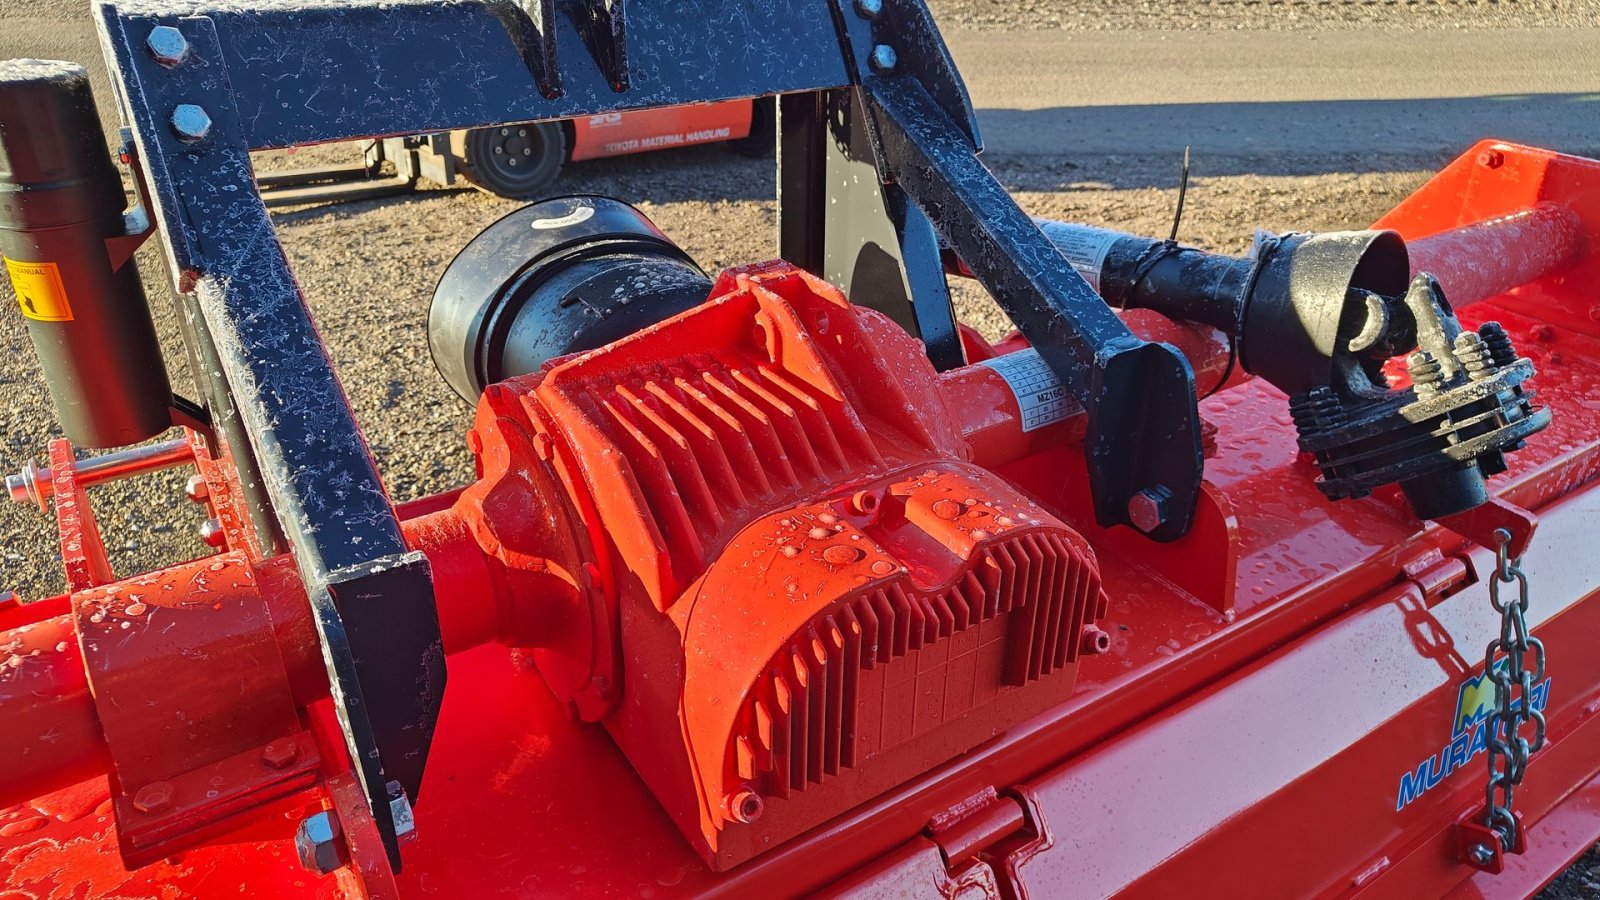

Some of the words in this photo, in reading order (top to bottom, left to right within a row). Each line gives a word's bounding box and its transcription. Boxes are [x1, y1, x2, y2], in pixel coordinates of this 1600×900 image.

[606, 140, 639, 152] TOYOTA
[641, 134, 684, 148] MATERIAL
[686, 127, 730, 142] HANDLING
[1037, 388, 1064, 403] MZ16C
